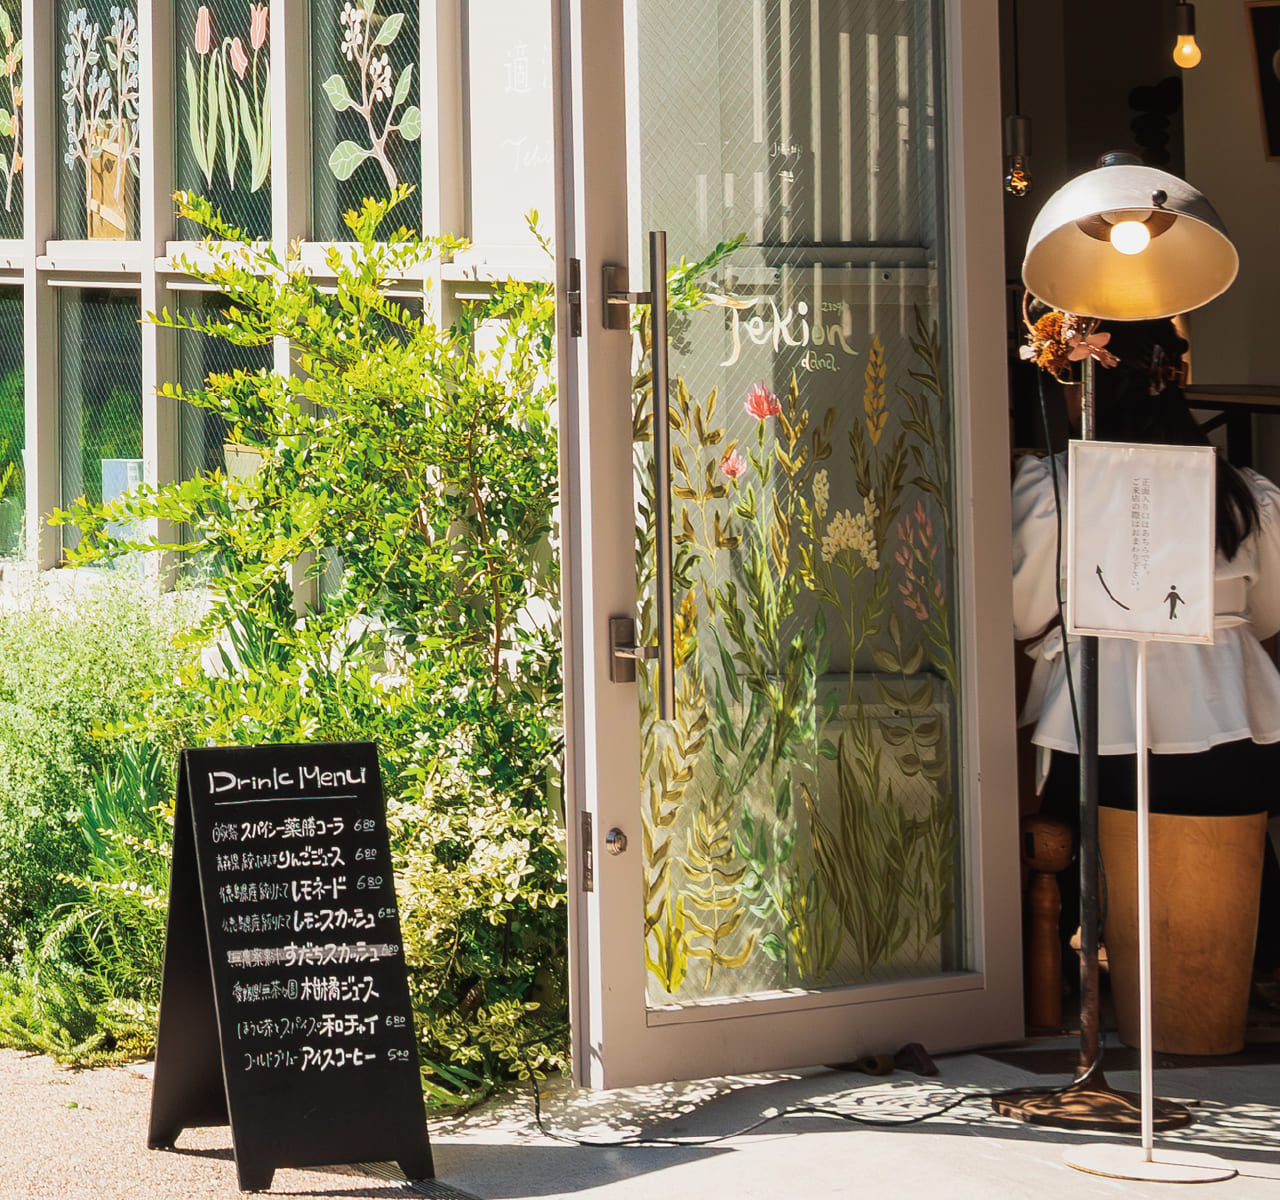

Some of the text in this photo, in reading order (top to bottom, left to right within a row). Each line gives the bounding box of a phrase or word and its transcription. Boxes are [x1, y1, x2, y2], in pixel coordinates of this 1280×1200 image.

[208, 765, 366, 794] Drink Menu
[240, 816, 345, 842] スパイシー薬膳コーラ
[353, 819, 376, 832] 680
[277, 845, 346, 869] りんごジュース
[354, 848, 377, 860] 680
[292, 876, 347, 903] レモネード
[356, 875, 383, 890] 680
[293, 908, 376, 932] レモンスカッシュ
[283, 941, 380, 967] すだちスカッシュ
[301, 976, 380, 1003] 柑橘ジュース
[385, 1015, 406, 1028] 680
[300, 1046, 376, 1071] アイスコーヒー
[387, 1048, 409, 1062] 540
